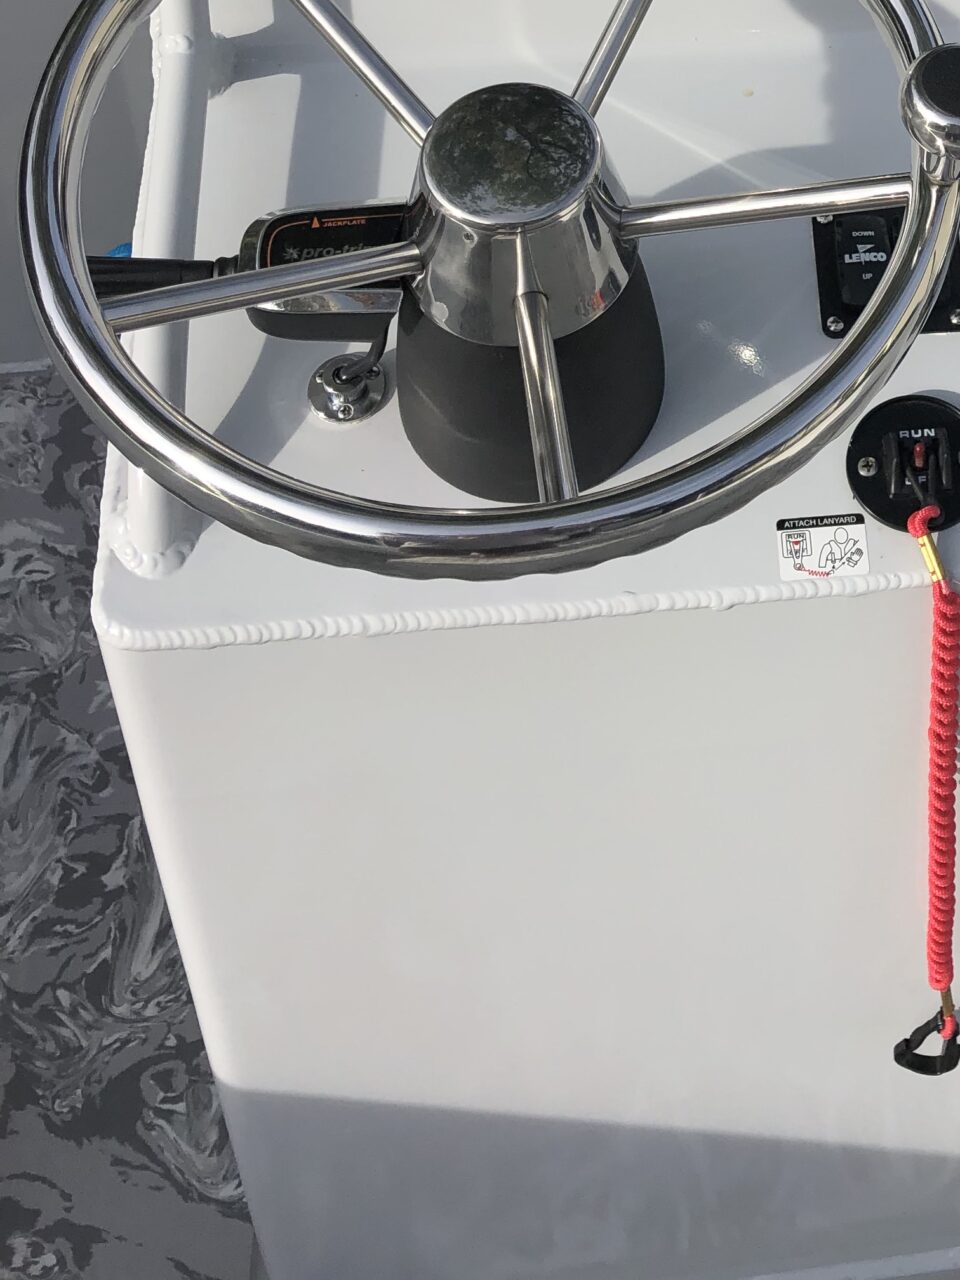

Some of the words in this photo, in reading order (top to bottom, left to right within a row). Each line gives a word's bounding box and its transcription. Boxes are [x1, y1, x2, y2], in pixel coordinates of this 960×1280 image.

[322, 219, 367, 227] JACKPLATE
[301, 242, 376, 261] pro-tri
[844, 252, 887, 264] LENCO
[862, 272, 873, 280] UP
[899, 428, 936, 438] RUN
[784, 519, 817, 528] ATTACH
[817, 516, 857, 525] LANYARD
